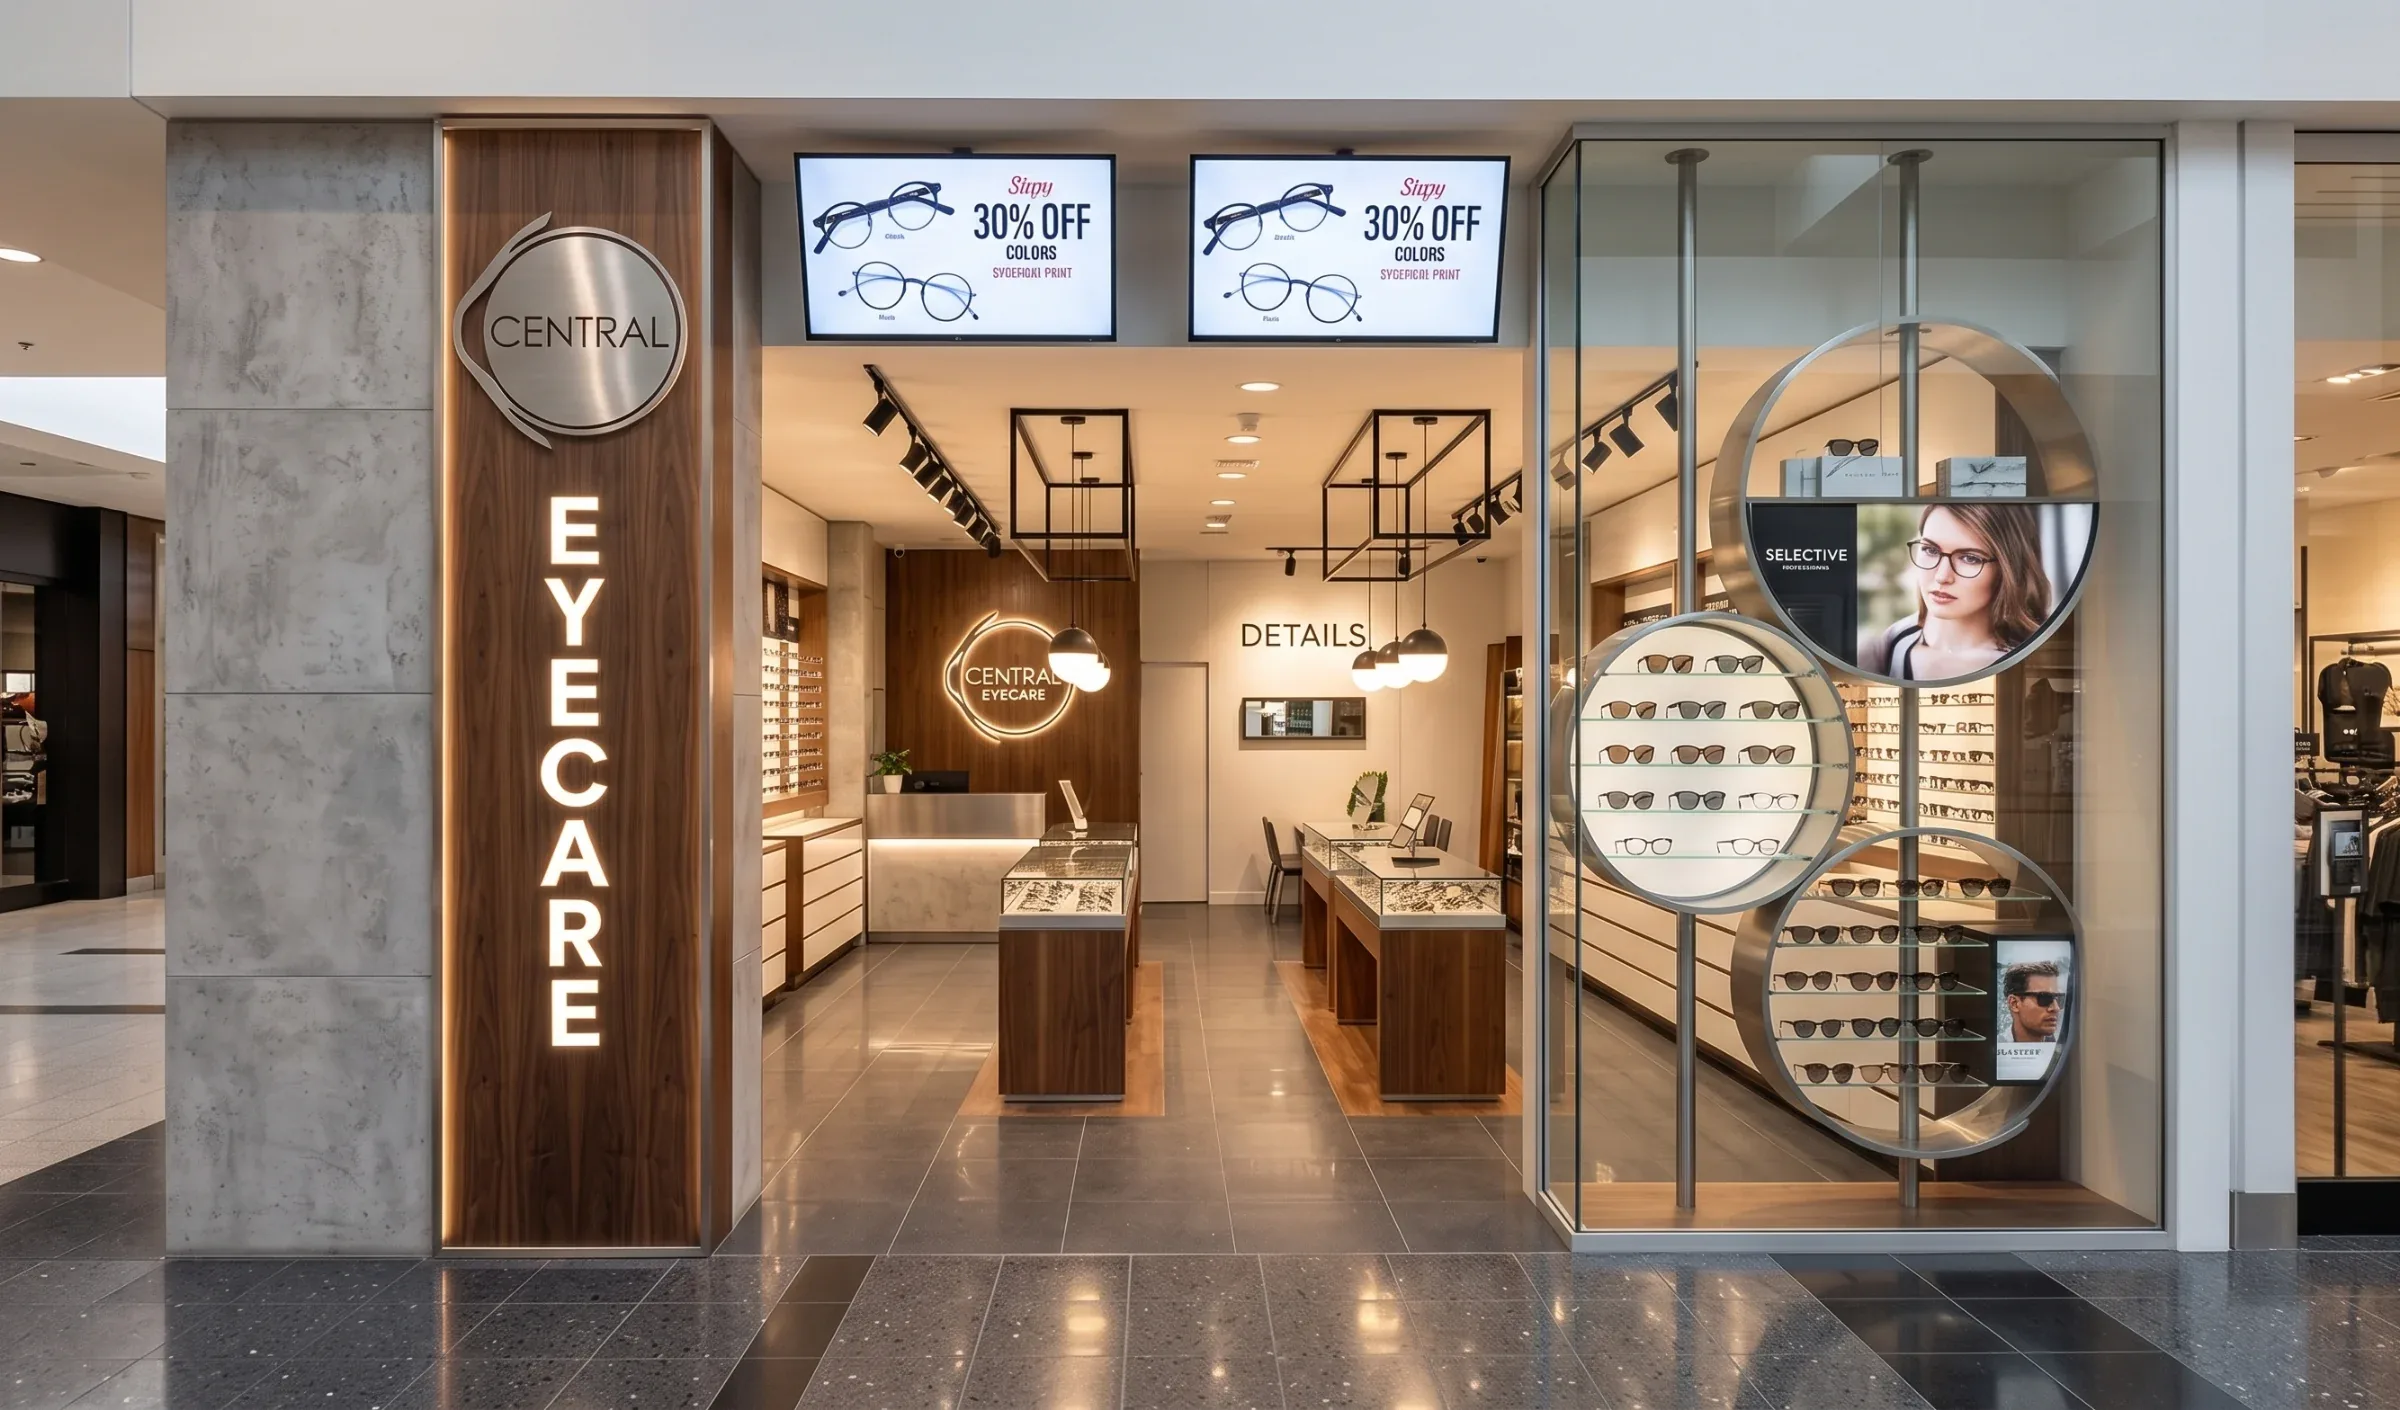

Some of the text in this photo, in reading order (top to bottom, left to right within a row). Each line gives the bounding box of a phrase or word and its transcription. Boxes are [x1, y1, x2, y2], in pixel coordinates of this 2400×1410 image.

[974, 203, 1091, 239] 30% OFF
[1364, 205, 1482, 241] 30% OFF
[1006, 245, 1057, 260] COLORS
[1395, 246, 1445, 262] COLORS
[1044, 267, 1073, 278] PRINT
[1432, 268, 1461, 280] PRINT
[490, 315, 670, 348] CENTRAL
[1765, 548, 1848, 561] SELECTIVE
[1242, 623, 1366, 647] DETAILS
[965, 667, 1062, 685] CENTRAL
[982, 689, 1046, 701] EYECARE
[540, 497, 609, 1047] EYECARE
